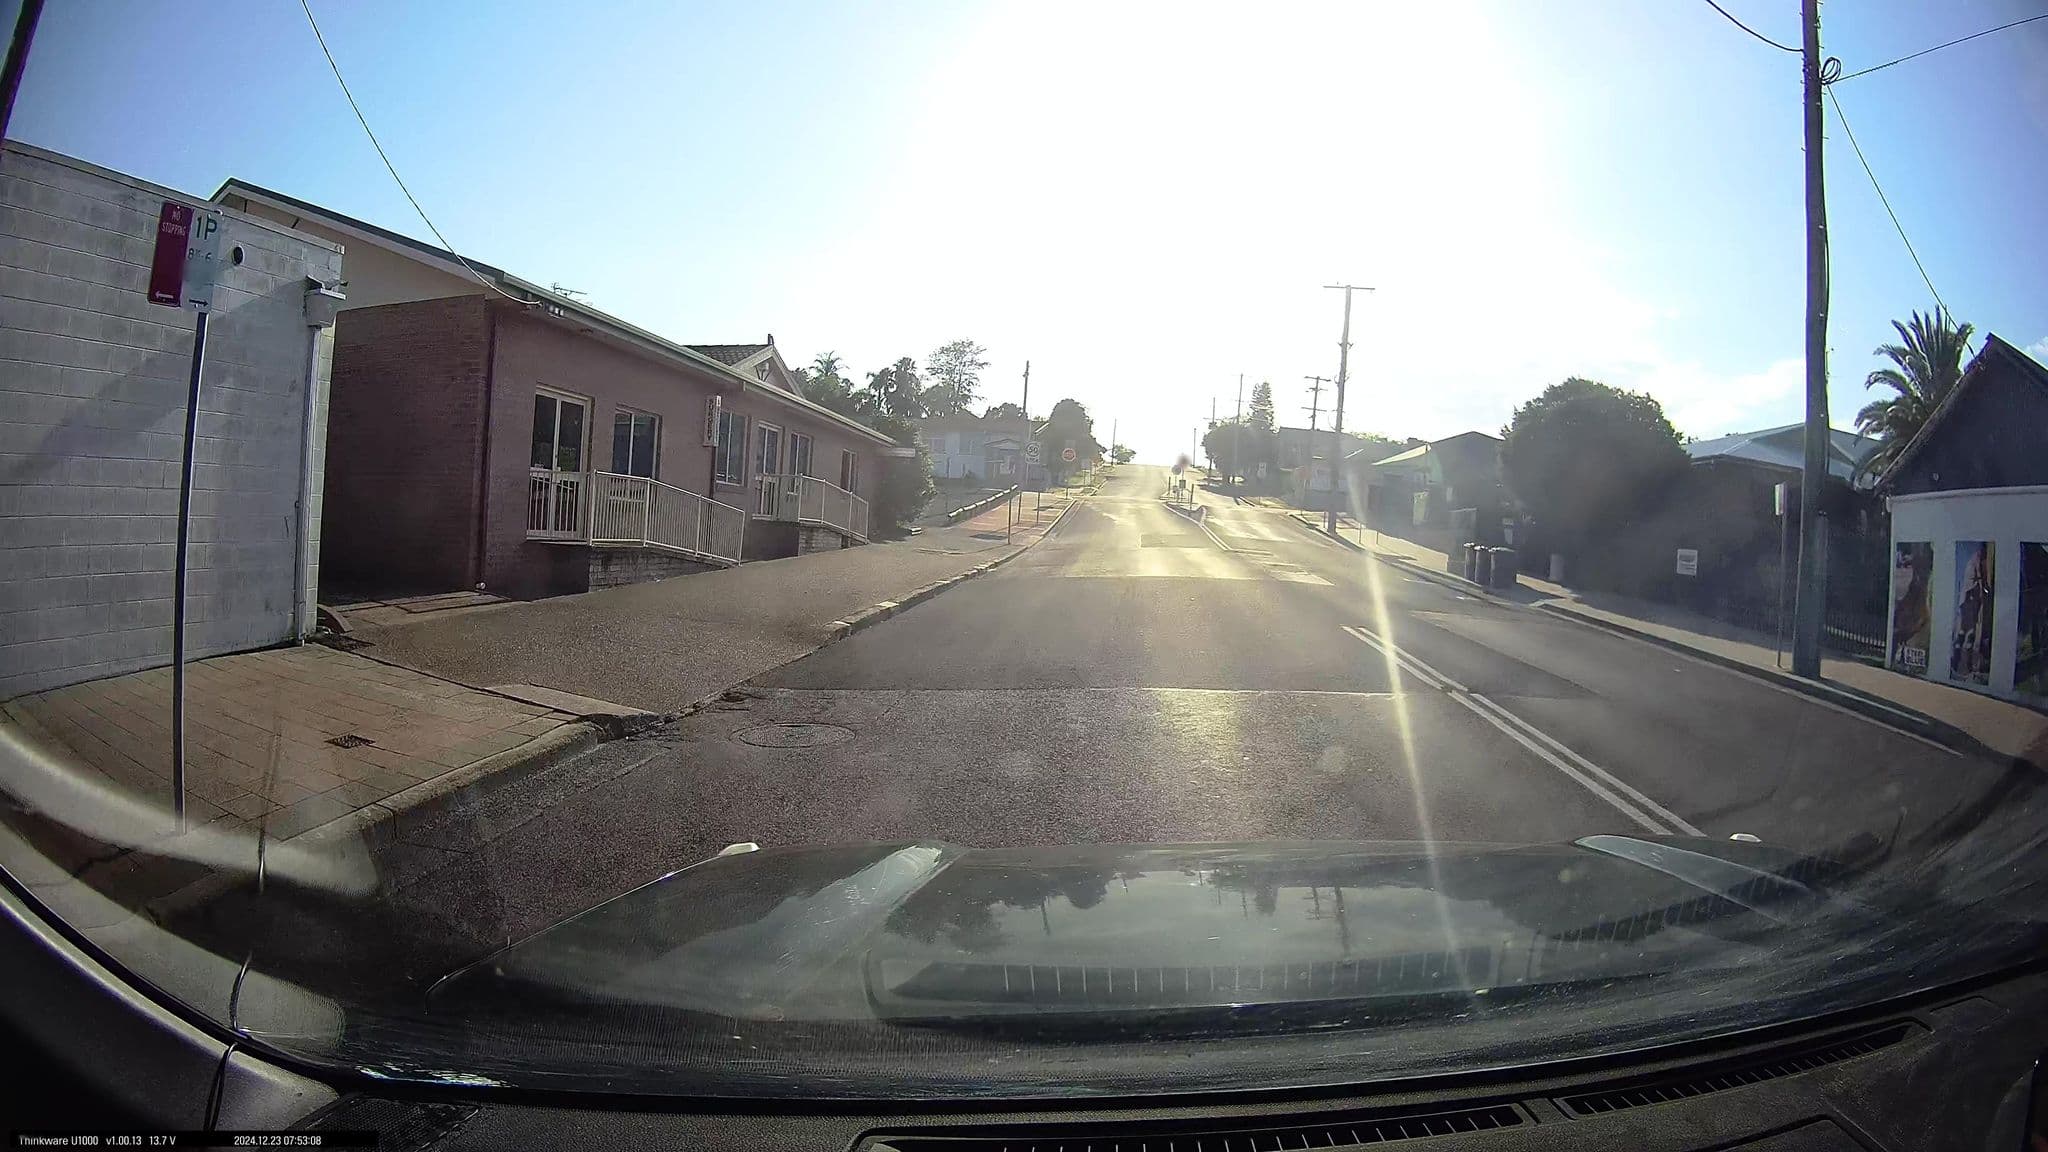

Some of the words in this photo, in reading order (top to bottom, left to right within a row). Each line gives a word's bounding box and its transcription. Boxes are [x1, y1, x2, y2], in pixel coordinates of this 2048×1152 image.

[171, 209, 181, 221] NO
[161, 222, 187, 236] STOPPING
[196, 213, 218, 240] 1P
